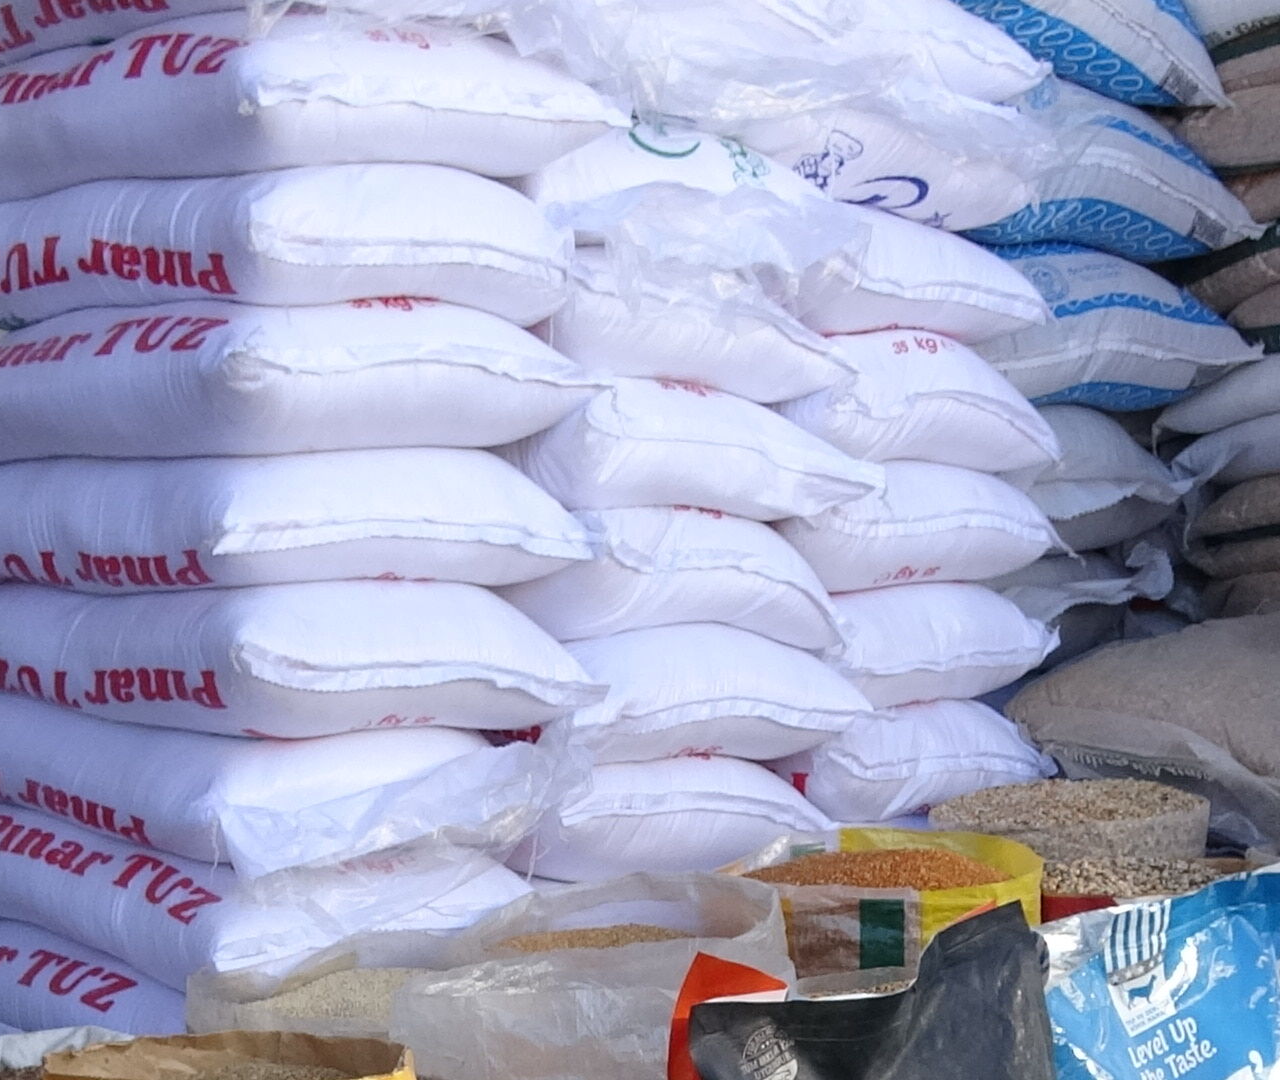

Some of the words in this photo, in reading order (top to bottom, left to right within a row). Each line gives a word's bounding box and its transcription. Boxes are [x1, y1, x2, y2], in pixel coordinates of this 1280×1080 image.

[124, 33, 248, 79] TUZ
[94, 316, 230, 358] TUZ
[892, 341, 909, 355] 35
[914, 336, 938, 354] kg
[114, 854, 223, 925] TUZ
[18, 948, 139, 1012] TUZ
[1128, 1030, 1168, 1068] Level
[1169, 1016, 1198, 1046] Up
[1166, 1036, 1218, 1078] Taste.
